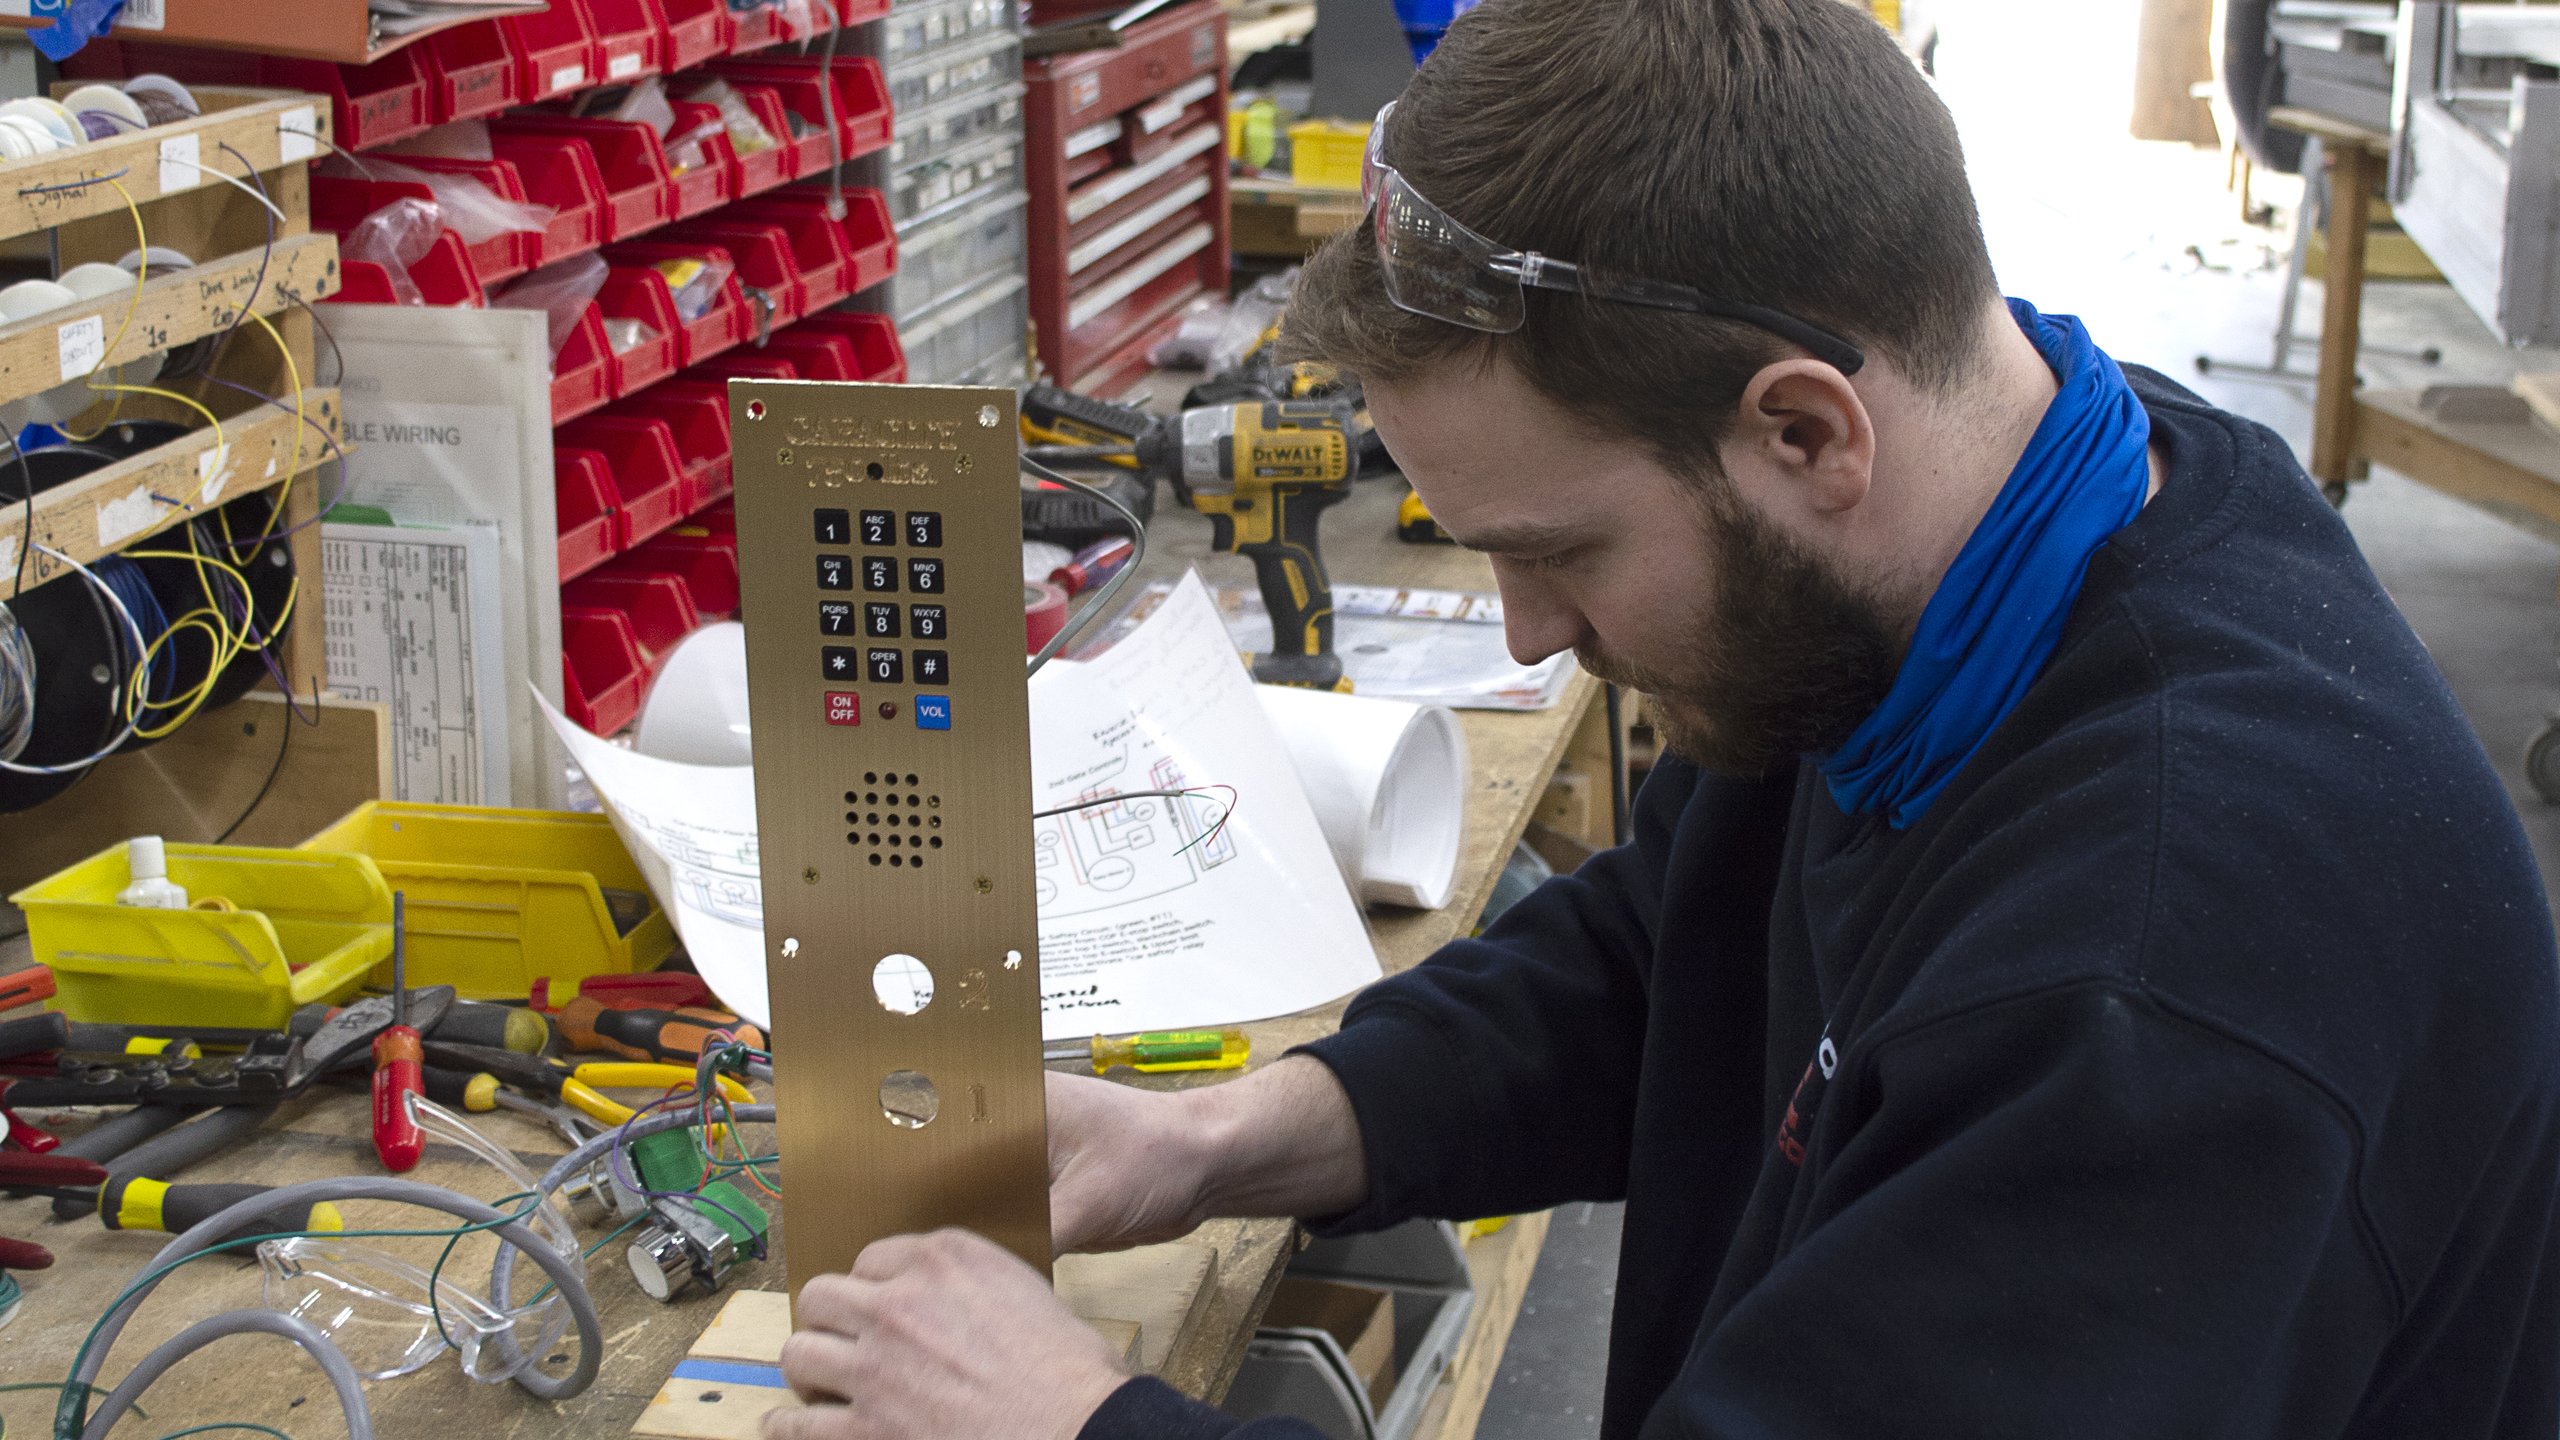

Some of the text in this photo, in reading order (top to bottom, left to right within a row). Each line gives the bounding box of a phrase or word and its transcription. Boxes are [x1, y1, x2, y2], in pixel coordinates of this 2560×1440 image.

[381, 423, 462, 447] WIRING
[785, 416, 962, 451] CAPACITY
[805, 456, 866, 489] 750
[865, 515, 885, 524] ABC
[911, 516, 930, 525] DEF
[826, 523, 835, 540] 1
[870, 526, 882, 541] 2
[916, 527, 928, 543] 3
[824, 561, 841, 569] GHI
[870, 562, 887, 570] JKL
[913, 563, 936, 573] MNO
[827, 570, 839, 586] 4
[873, 571, 885, 587] 5
[919, 573, 932, 589] 6
[822, 605, 849, 615] PQRS
[872, 606, 891, 616] TUV
[913, 608, 940, 618] WXYZ
[831, 616, 841, 631] 7
[876, 617, 887, 632] 8
[922, 619, 933, 635] 9
[870, 652, 897, 662] OPER
[879, 662, 890, 678] 0
[924, 659, 936, 675] #
[832, 696, 851, 707] ON
[830, 709, 854, 720] OFF
[920, 706, 945, 717] VOL
[958, 968, 990, 1013] 2
[967, 1083, 994, 1124] 1
